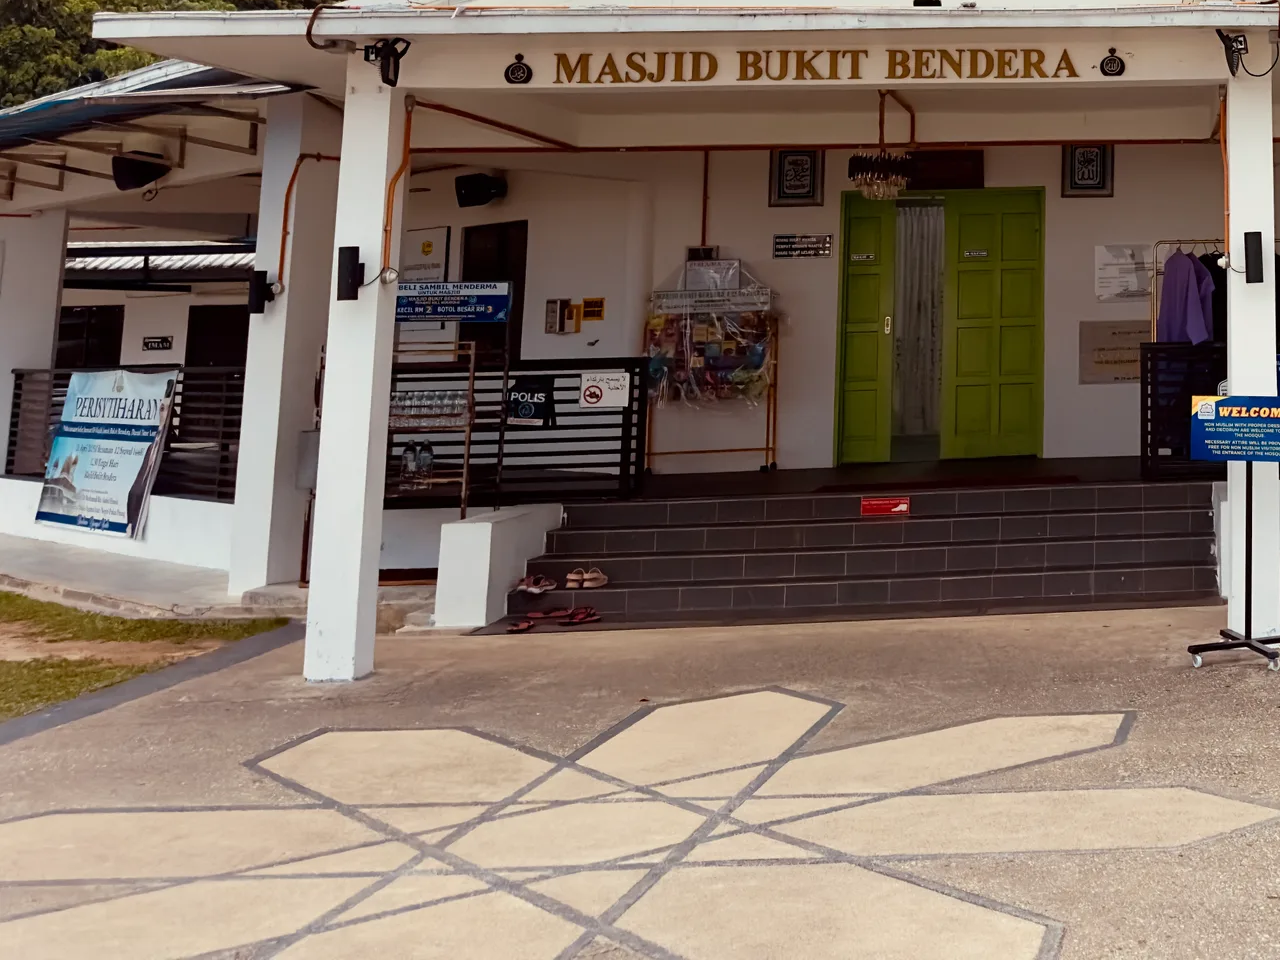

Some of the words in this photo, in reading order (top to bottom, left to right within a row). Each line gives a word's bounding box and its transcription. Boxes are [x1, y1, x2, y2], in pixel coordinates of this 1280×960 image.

[552, 50, 718, 84] MASJID
[736, 49, 868, 81] BUKIT
[885, 48, 1080, 79] BENDERA
[426, 305, 432, 313] 2
[487, 305, 492, 313] 3
[510, 392, 546, 403] POLIS
[75, 397, 161, 420] PERISYTIHARAN
